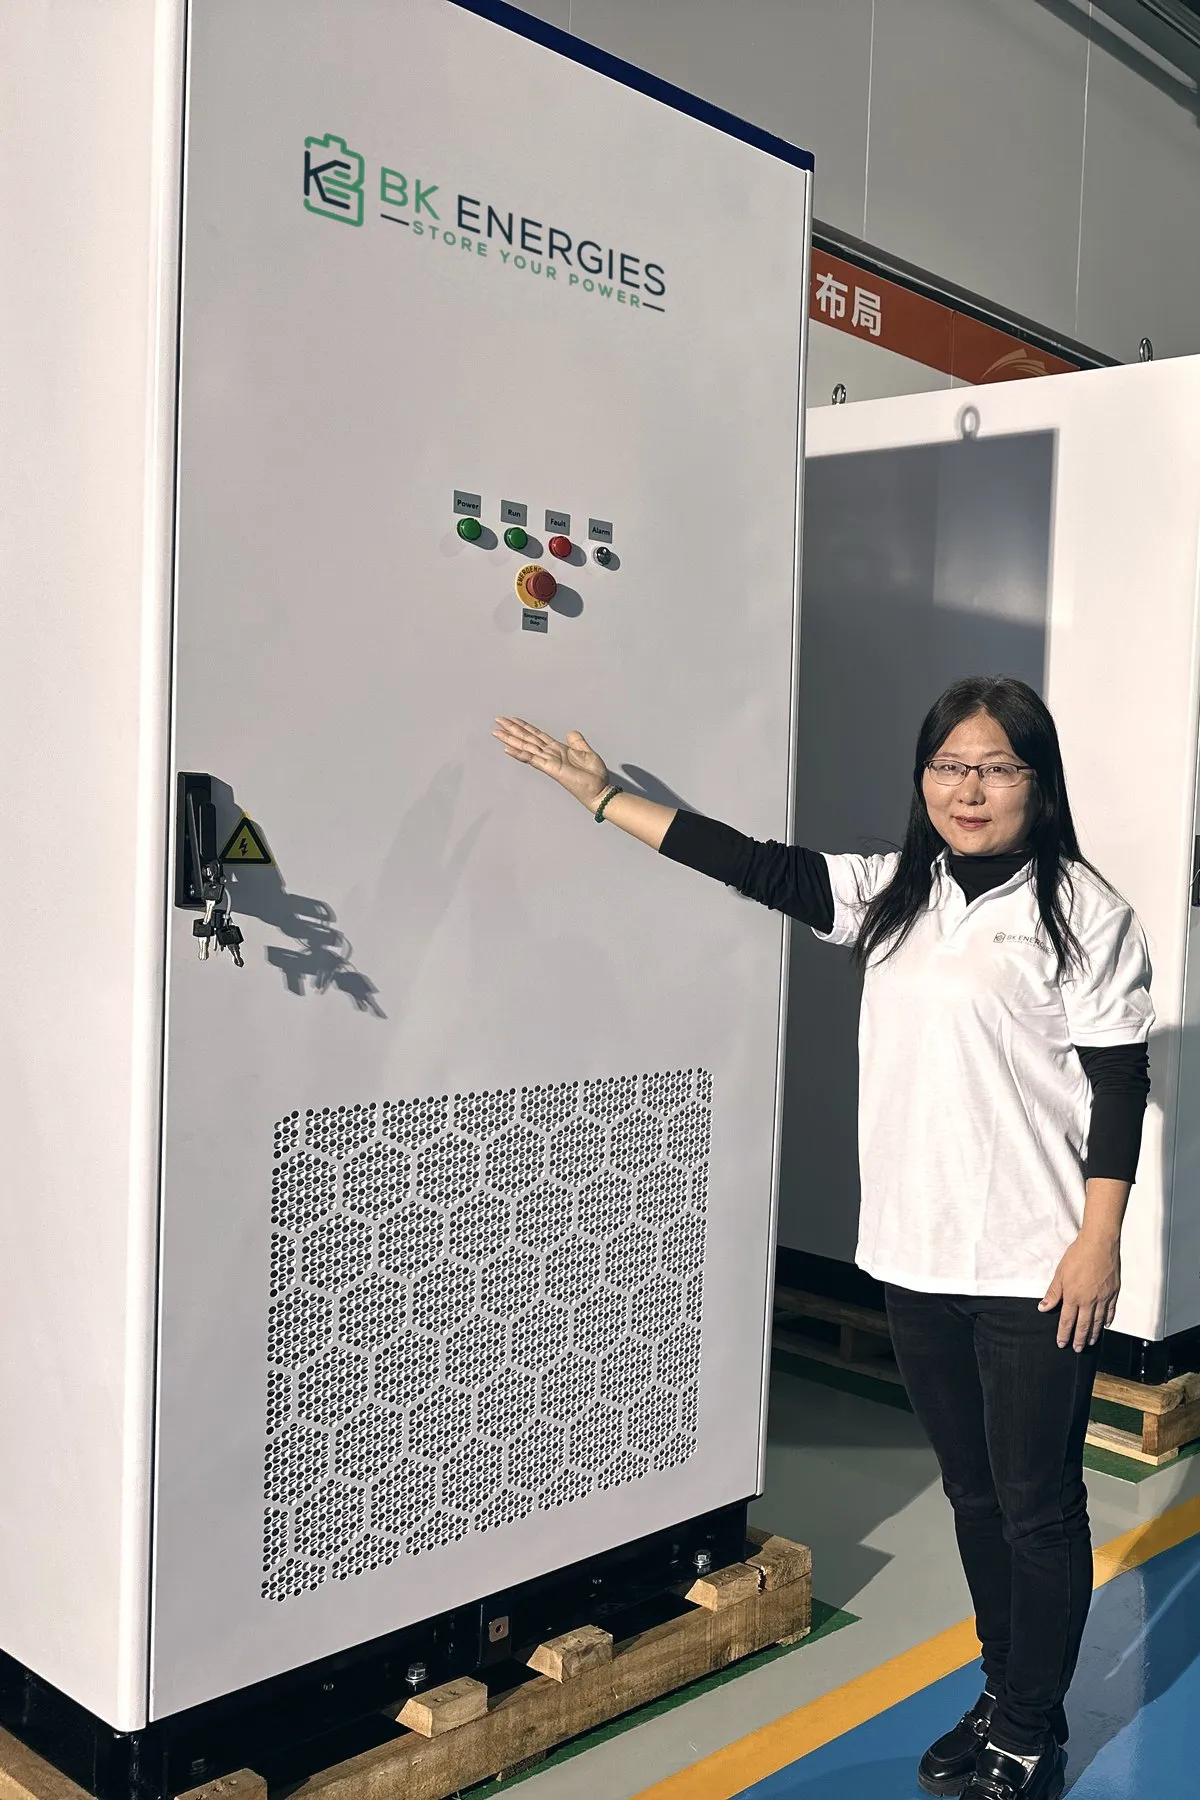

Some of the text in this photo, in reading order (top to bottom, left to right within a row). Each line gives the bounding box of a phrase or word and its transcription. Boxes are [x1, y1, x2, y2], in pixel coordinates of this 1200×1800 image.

[380, 165, 666, 297] BK ENERGIES
[412, 220, 641, 308] STORE YOUR POWER
[457, 499, 480, 511] Power
[507, 508, 521, 519] Run
[550, 518, 567, 528] Fault
[591, 527, 611, 536] Alarm
[516, 565, 548, 587] EMERGENC
[524, 612, 548, 622] Emergency
